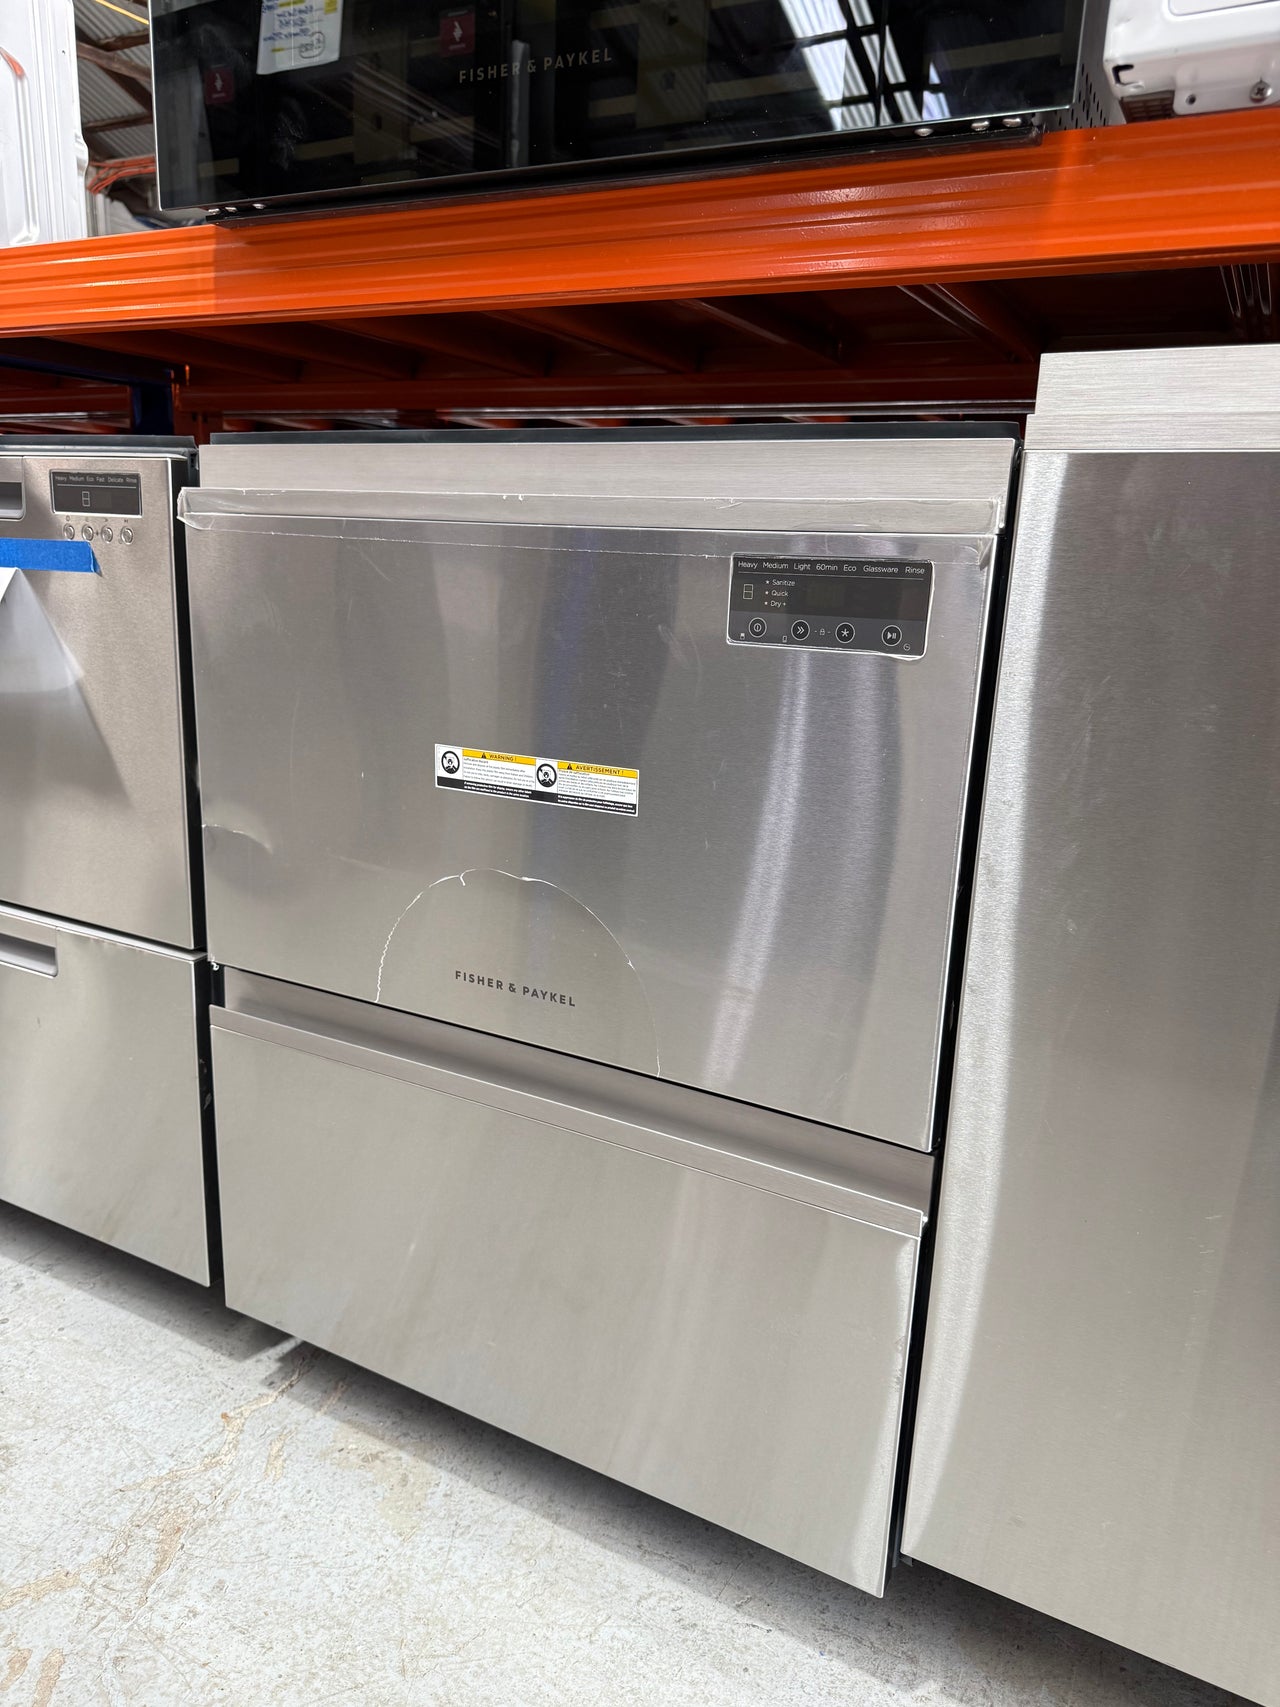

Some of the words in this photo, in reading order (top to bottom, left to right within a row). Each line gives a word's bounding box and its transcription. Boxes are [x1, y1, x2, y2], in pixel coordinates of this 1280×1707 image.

[459, 62, 521, 84] FISHER
[527, 60, 537, 73] &
[543, 48, 612, 71] PAYKEL
[738, 561, 758, 569] Heavy
[762, 561, 789, 569] Medium
[793, 562, 811, 571] Light
[815, 563, 838, 572] 60min
[843, 564, 857, 572] Eco
[863, 565, 899, 573] Glassware
[905, 566, 925, 574] Rinse
[772, 579, 796, 587] Sanitize
[771, 590, 789, 598] Quick
[770, 600, 782, 609] Dry
[489, 754, 514, 762] WARNING
[575, 765, 620, 775] AVERTISSEMENT
[455, 970, 504, 990] FISHER
[508, 982, 517, 994] &
[522, 986, 576, 1007] PAYKEL
